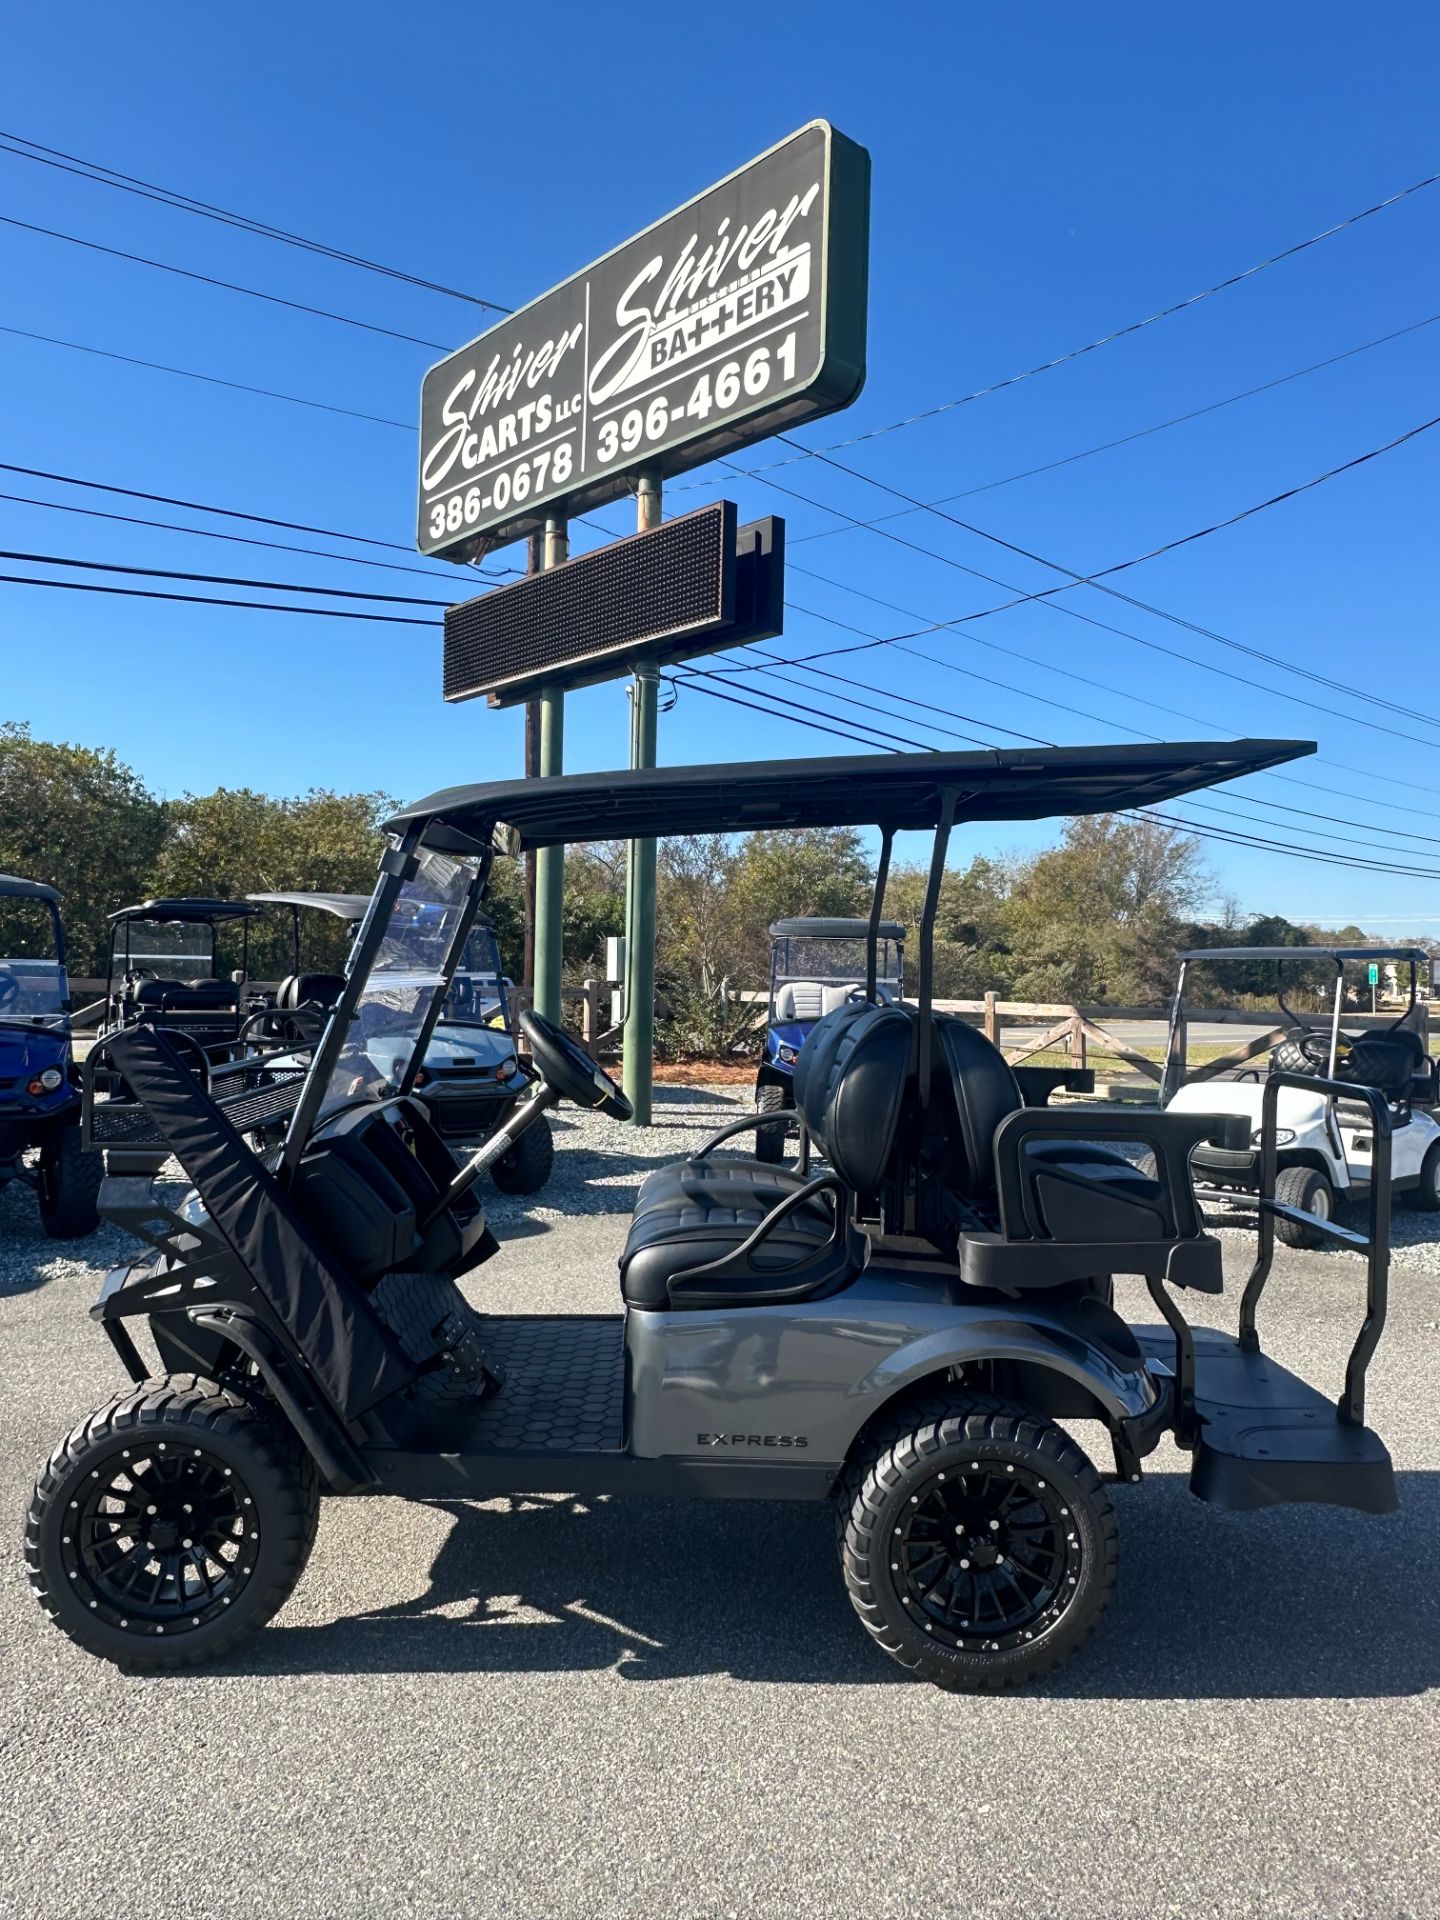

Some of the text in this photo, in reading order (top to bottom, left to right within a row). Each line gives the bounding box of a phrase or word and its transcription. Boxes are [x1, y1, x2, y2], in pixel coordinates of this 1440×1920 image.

[588, 183, 819, 405] Shiver
[422, 323, 583, 490] Shiver
[462, 394, 582, 469] CARTS LLC
[597, 332, 796, 463] 396-4661
[429, 443, 573, 539] 386-0678
[697, 1433, 808, 1447] EXPRESS
